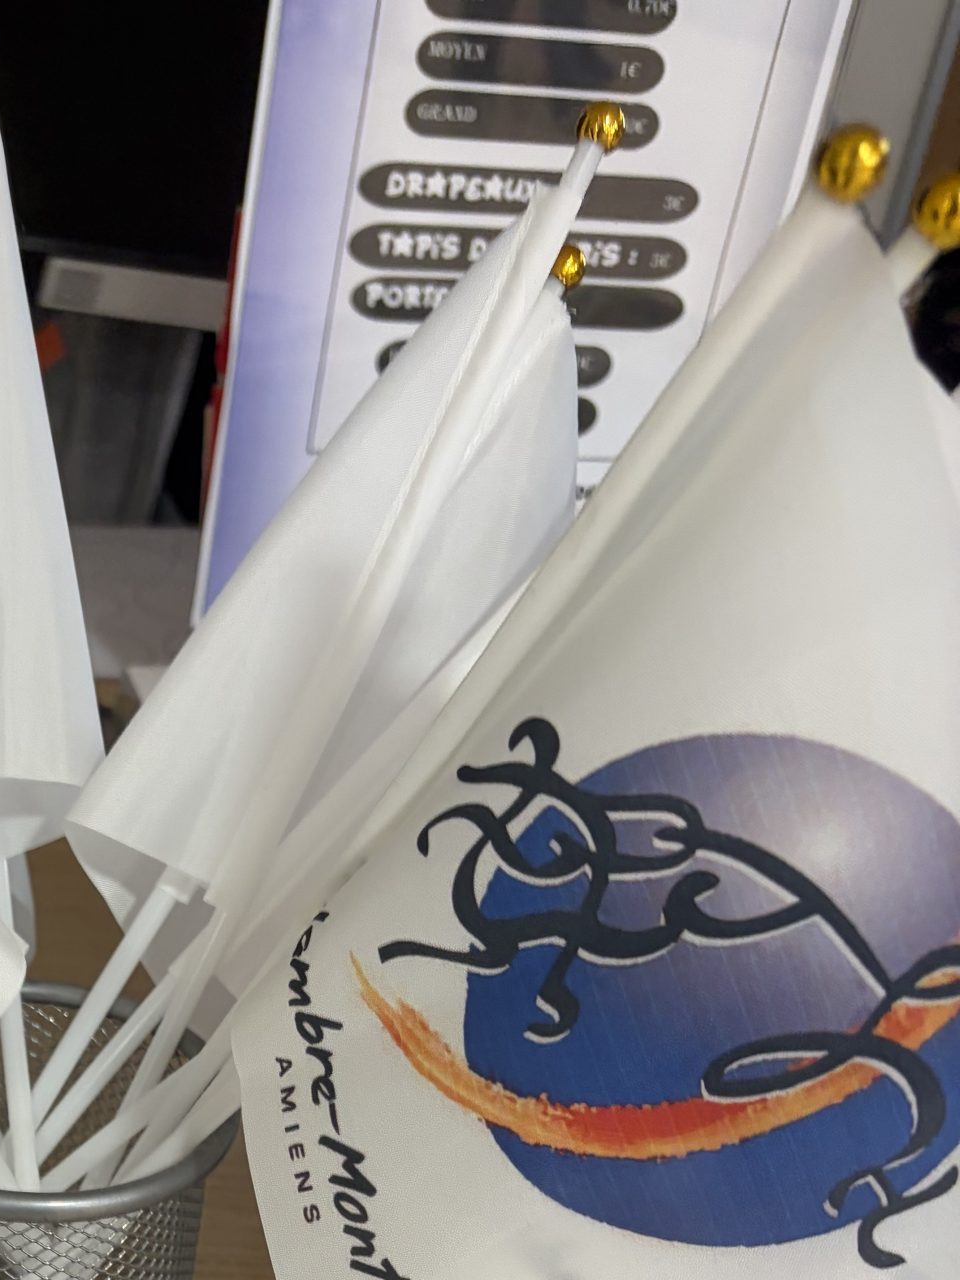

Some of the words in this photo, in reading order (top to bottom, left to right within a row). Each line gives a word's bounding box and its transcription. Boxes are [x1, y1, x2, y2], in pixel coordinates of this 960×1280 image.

[428, 40, 488, 61] MOYEN
[416, 103, 478, 123] GRAND
[274, 1056, 321, 1224] AMIENS
